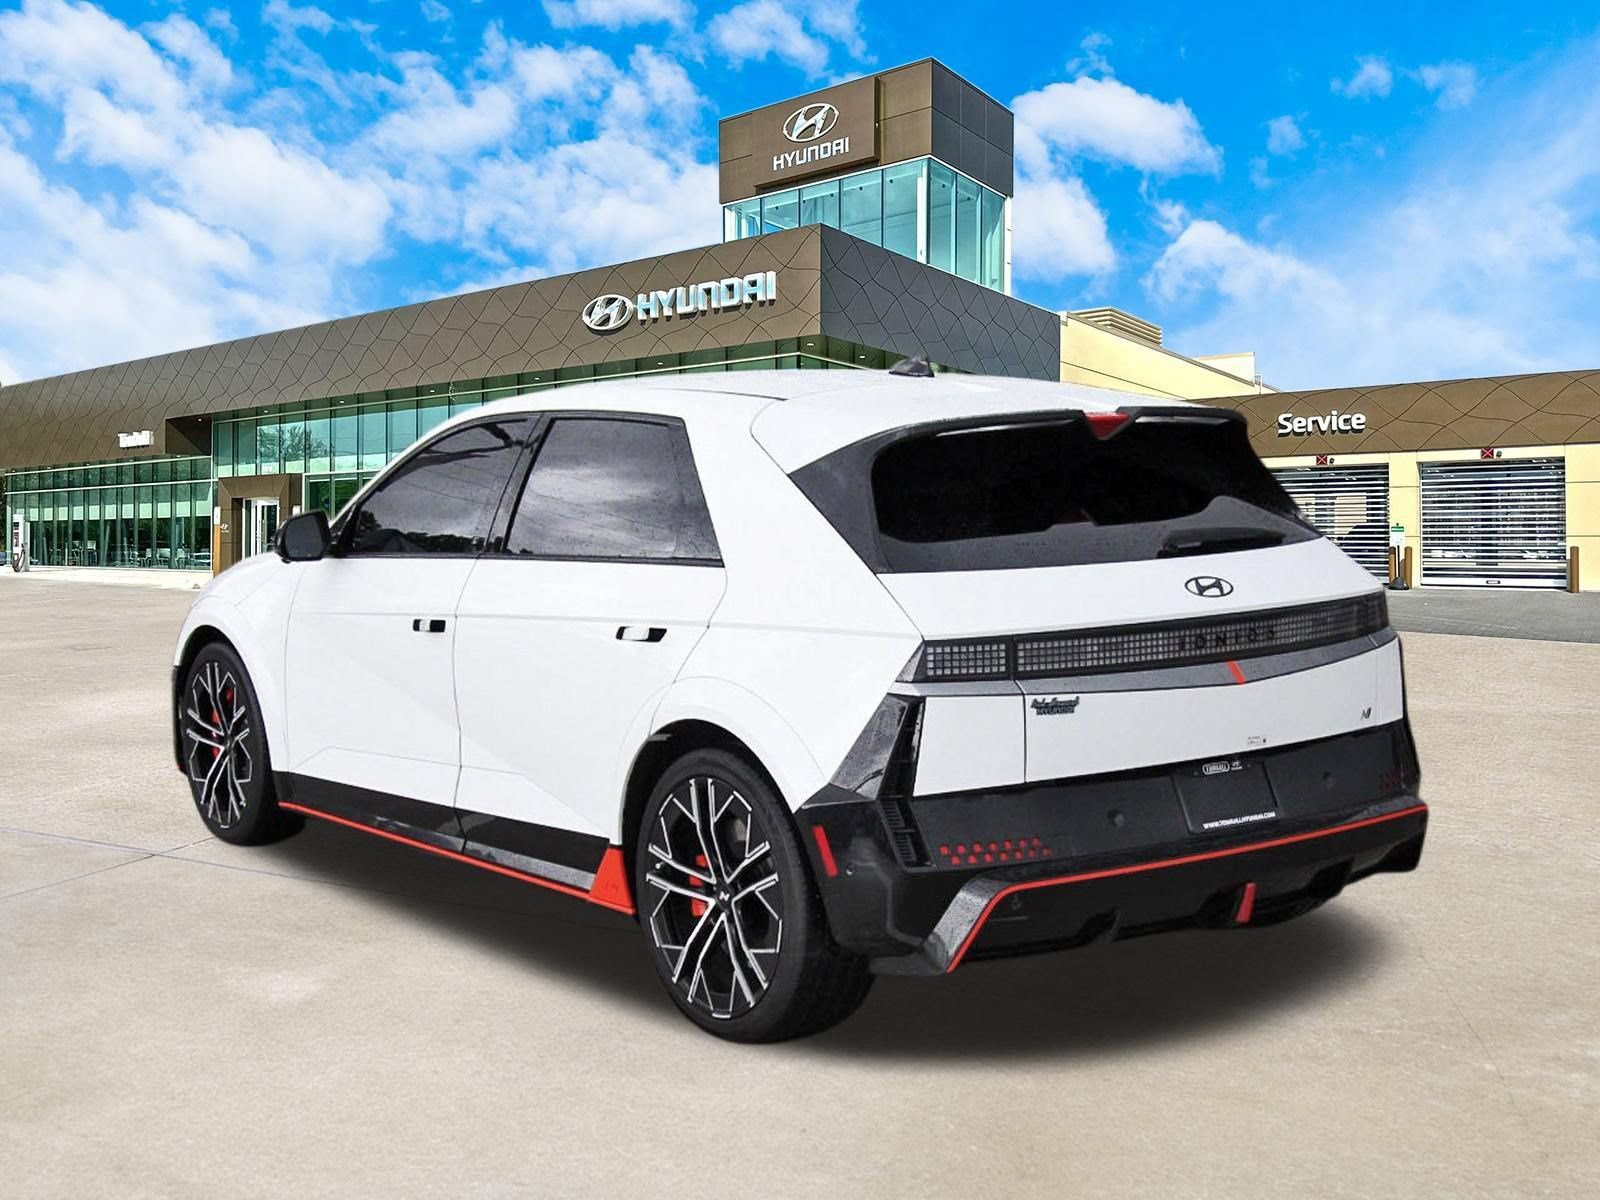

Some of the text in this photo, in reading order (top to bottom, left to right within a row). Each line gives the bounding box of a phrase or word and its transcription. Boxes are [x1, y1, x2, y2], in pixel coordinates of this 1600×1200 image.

[773, 137, 849, 170] HYUNDAI
[636, 271, 777, 320] HYUNDAI
[1278, 411, 1366, 434] Service
